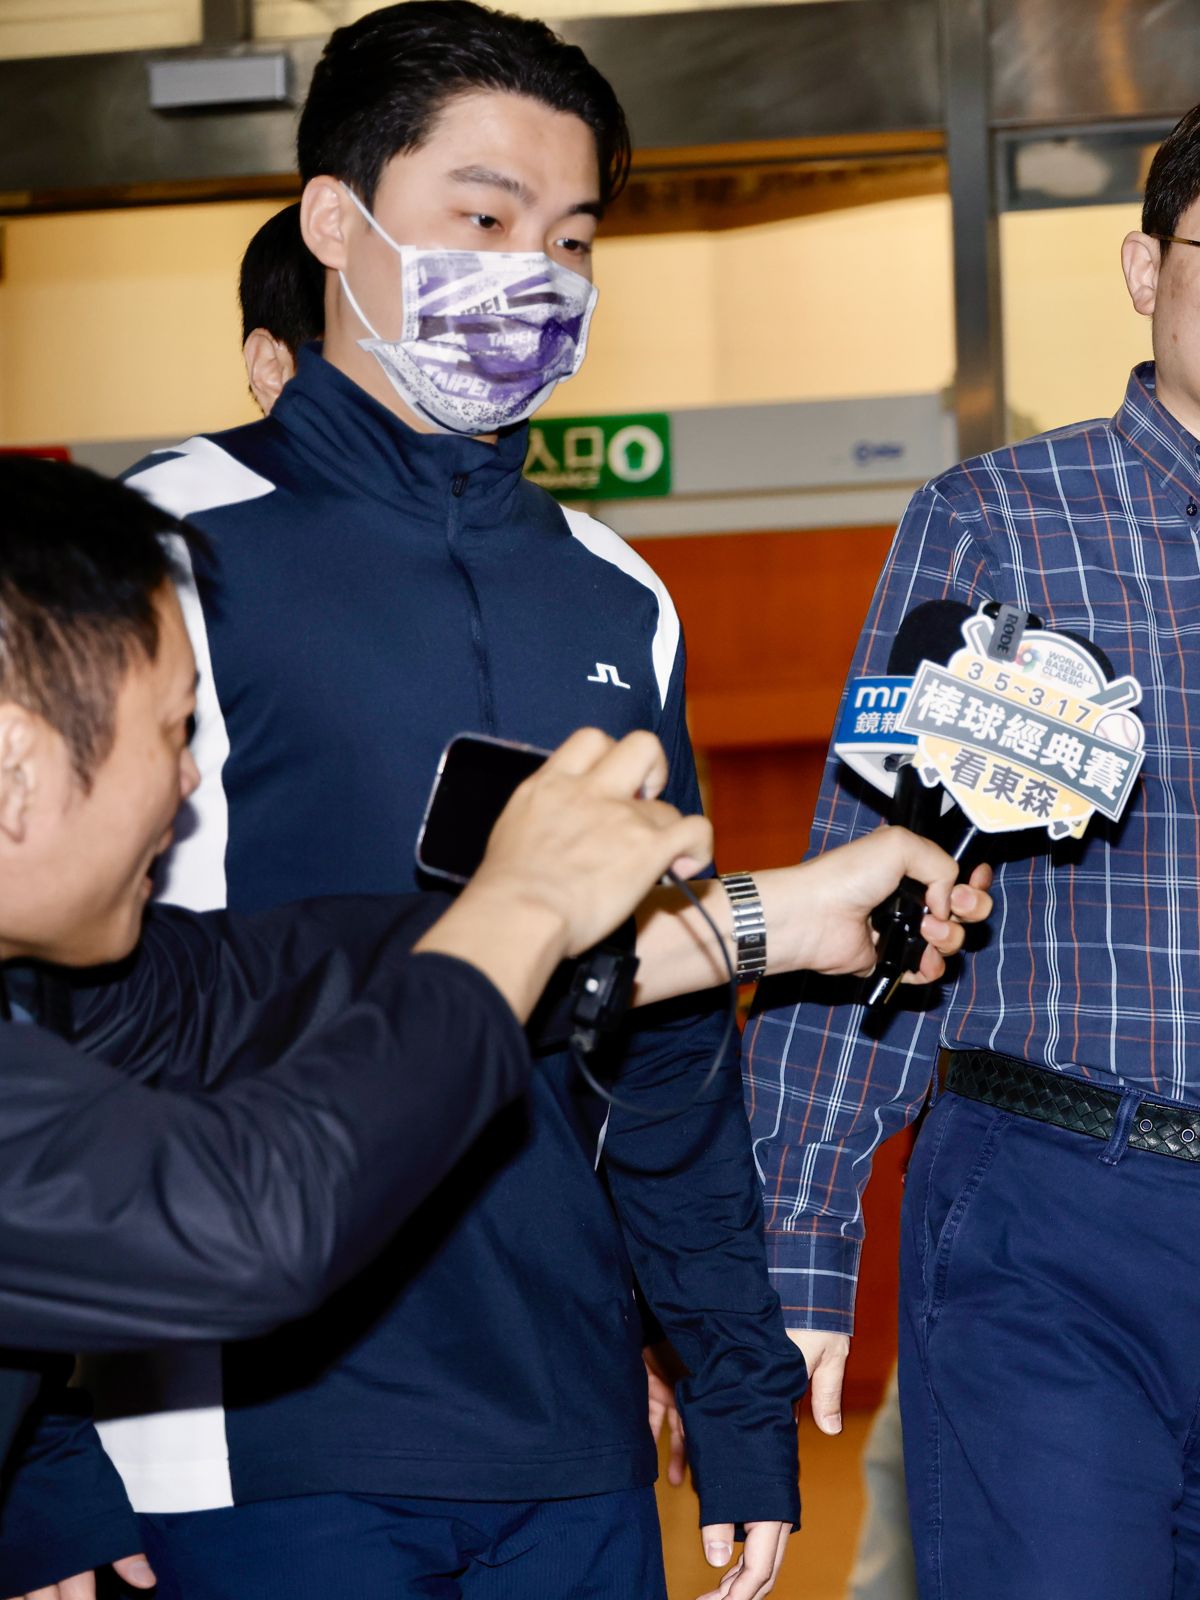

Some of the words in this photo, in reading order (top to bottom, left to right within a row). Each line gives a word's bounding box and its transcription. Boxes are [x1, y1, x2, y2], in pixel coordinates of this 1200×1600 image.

[422, 363, 493, 398] TAIPEI
[522, 426, 605, 473] 入口
[1041, 665, 1084, 689] CLASSIC
[1045, 658, 1094, 685] BASEBALL
[1048, 650, 1085, 671] WORLD
[917, 678, 1130, 801] 棒球經典賽
[950, 748, 1059, 819] 看東森
